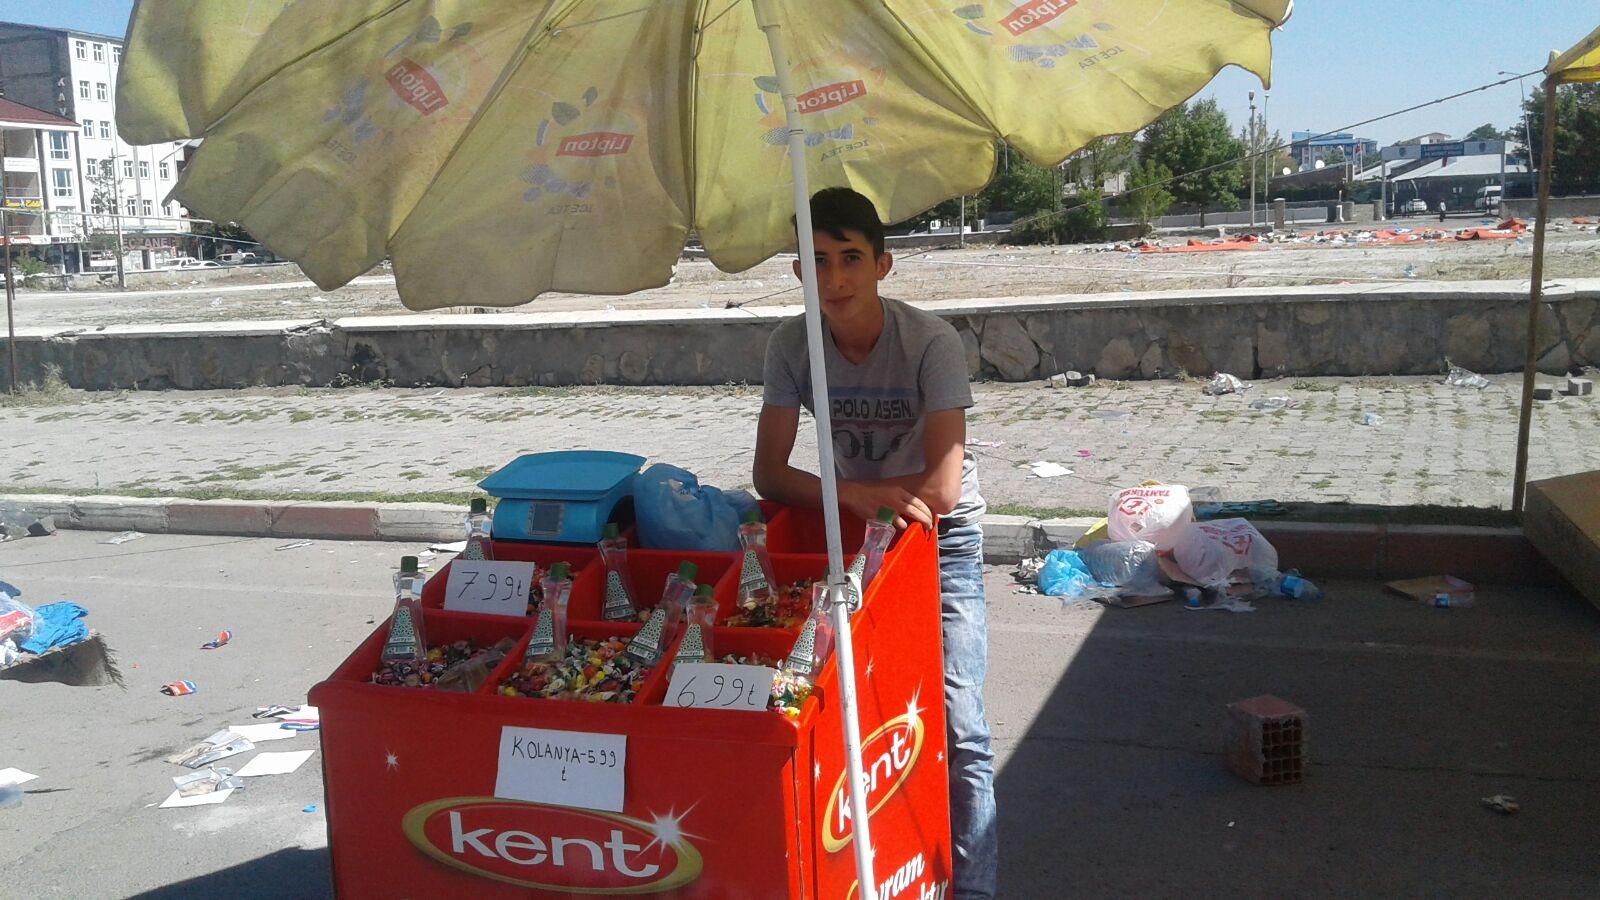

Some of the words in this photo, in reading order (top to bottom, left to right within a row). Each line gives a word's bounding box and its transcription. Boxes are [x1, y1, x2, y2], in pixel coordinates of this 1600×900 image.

[123, 238, 168, 249] ECANE
[833, 399, 870, 418] POLO
[874, 399, 914, 419] ASSN.
[449, 811, 660, 878] kent
